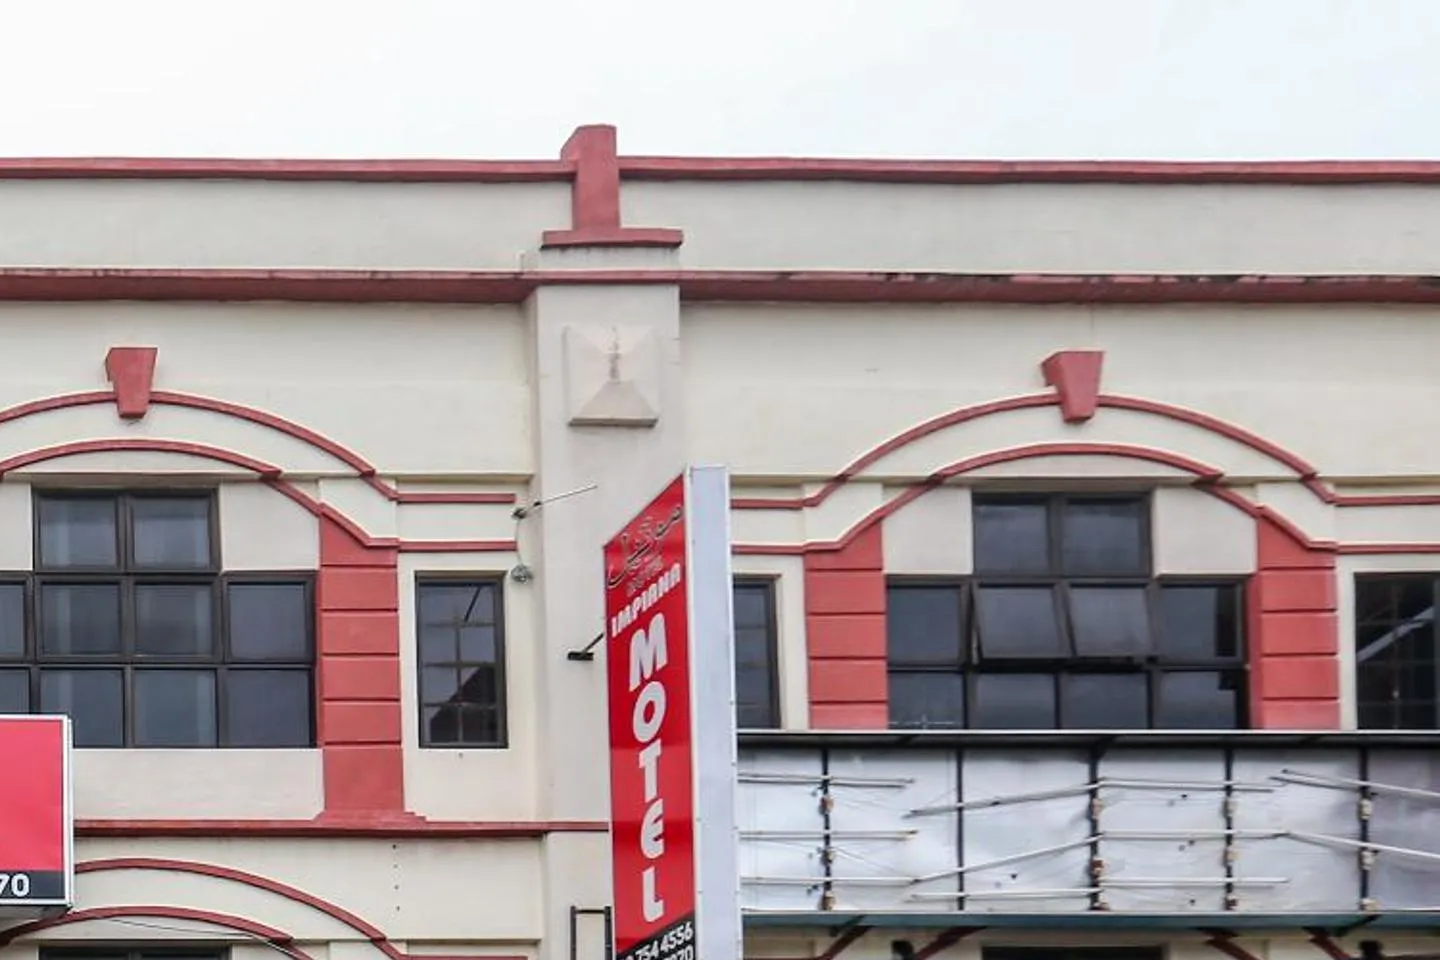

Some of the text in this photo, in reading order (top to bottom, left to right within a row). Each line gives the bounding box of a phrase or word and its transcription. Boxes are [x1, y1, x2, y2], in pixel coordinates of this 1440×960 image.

[611, 562, 681, 638] IMPIANA
[628, 612, 668, 922] MOTEL
[660, 920, 694, 953] 4556
